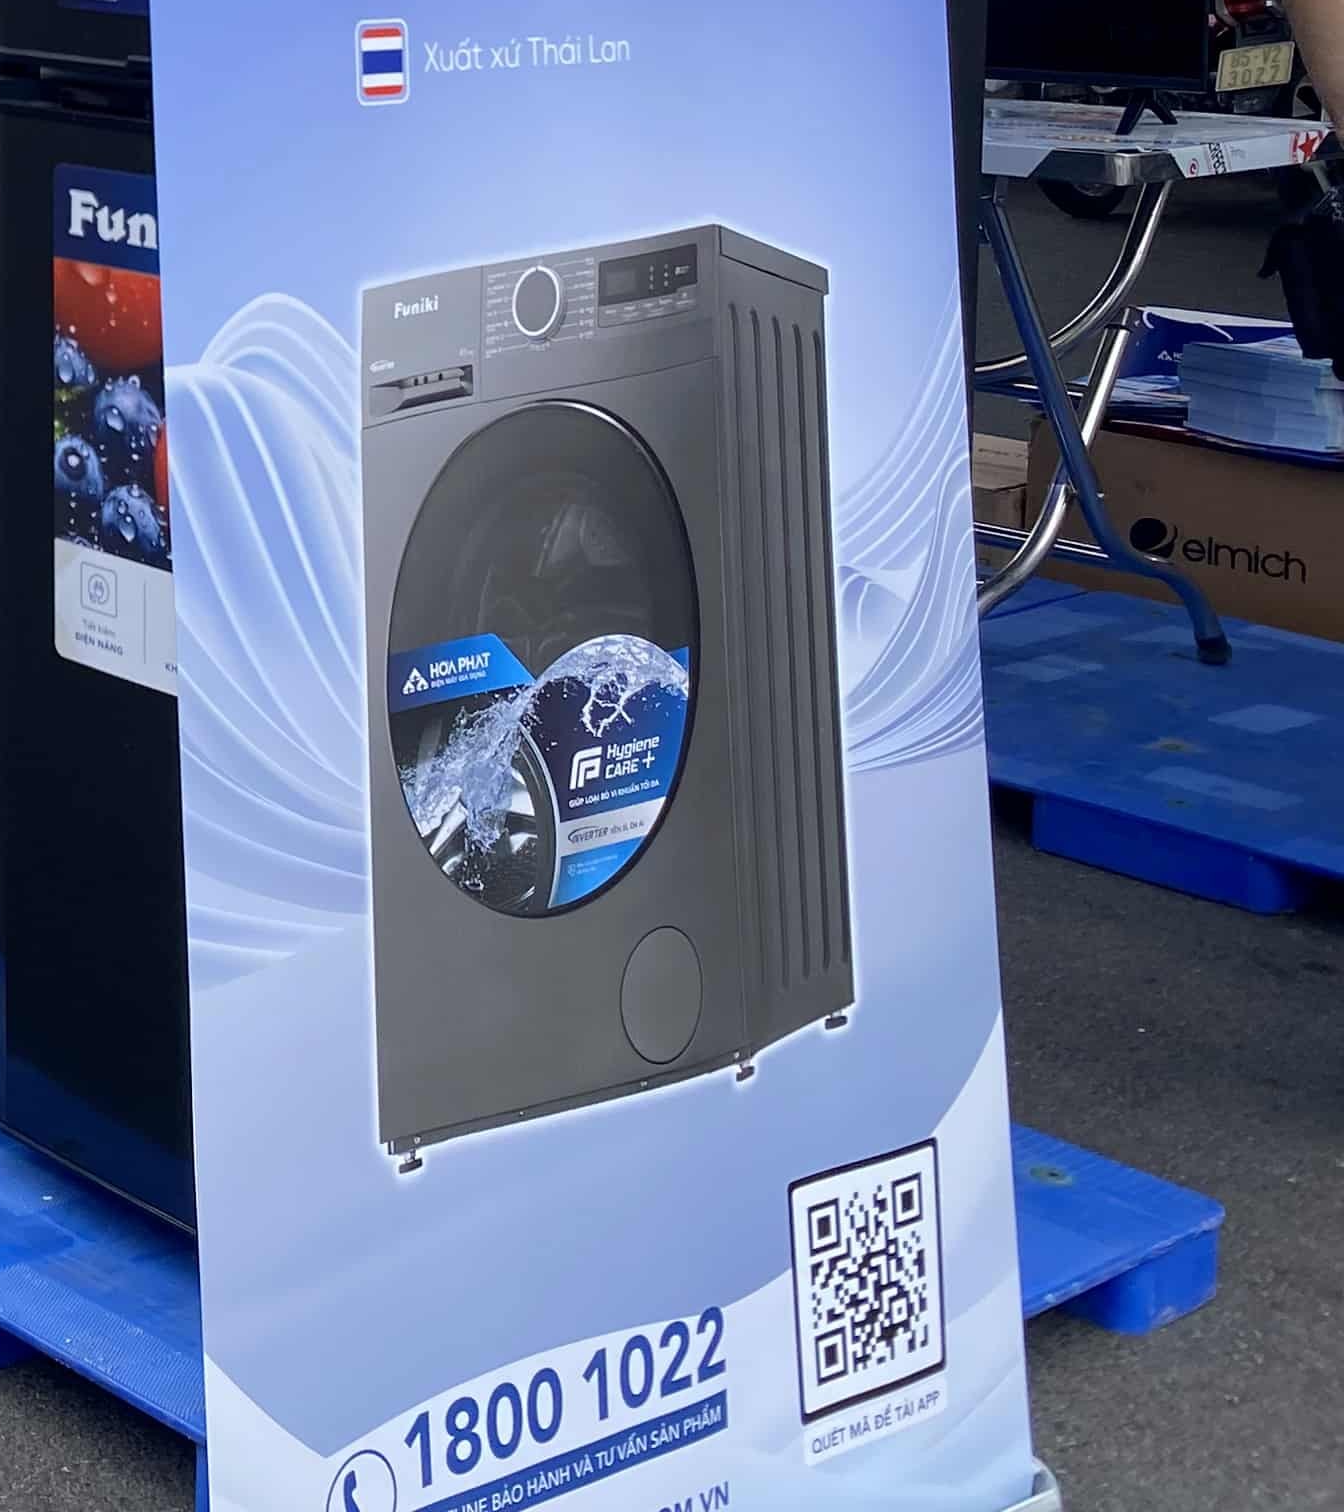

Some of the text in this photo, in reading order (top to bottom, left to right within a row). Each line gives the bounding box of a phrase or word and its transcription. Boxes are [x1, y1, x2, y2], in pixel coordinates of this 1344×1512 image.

[423, 34, 631, 73] Xuất xứ Thái Lan
[68, 188, 158, 250] Fun
[393, 295, 439, 319] Funiki
[1182, 536, 1306, 584] elmich
[605, 758, 640, 779] CARE
[607, 736, 660, 760] Hygiene
[404, 1306, 727, 1489] 1800 1022
[811, 1427, 845, 1454] QUÉT
[874, 1403, 892, 1430] ĐỂ
[917, 1390, 940, 1413] APP
[491, 1483, 523, 1512] BẢO
[526, 1465, 572, 1498] HÀNH
[573, 1457, 593, 1479] VÀ
[595, 1449, 617, 1471] TƯ
[618, 1432, 647, 1463] VẤN
[649, 1423, 680, 1449] SẢN
[682, 1404, 722, 1439] PHẨM
